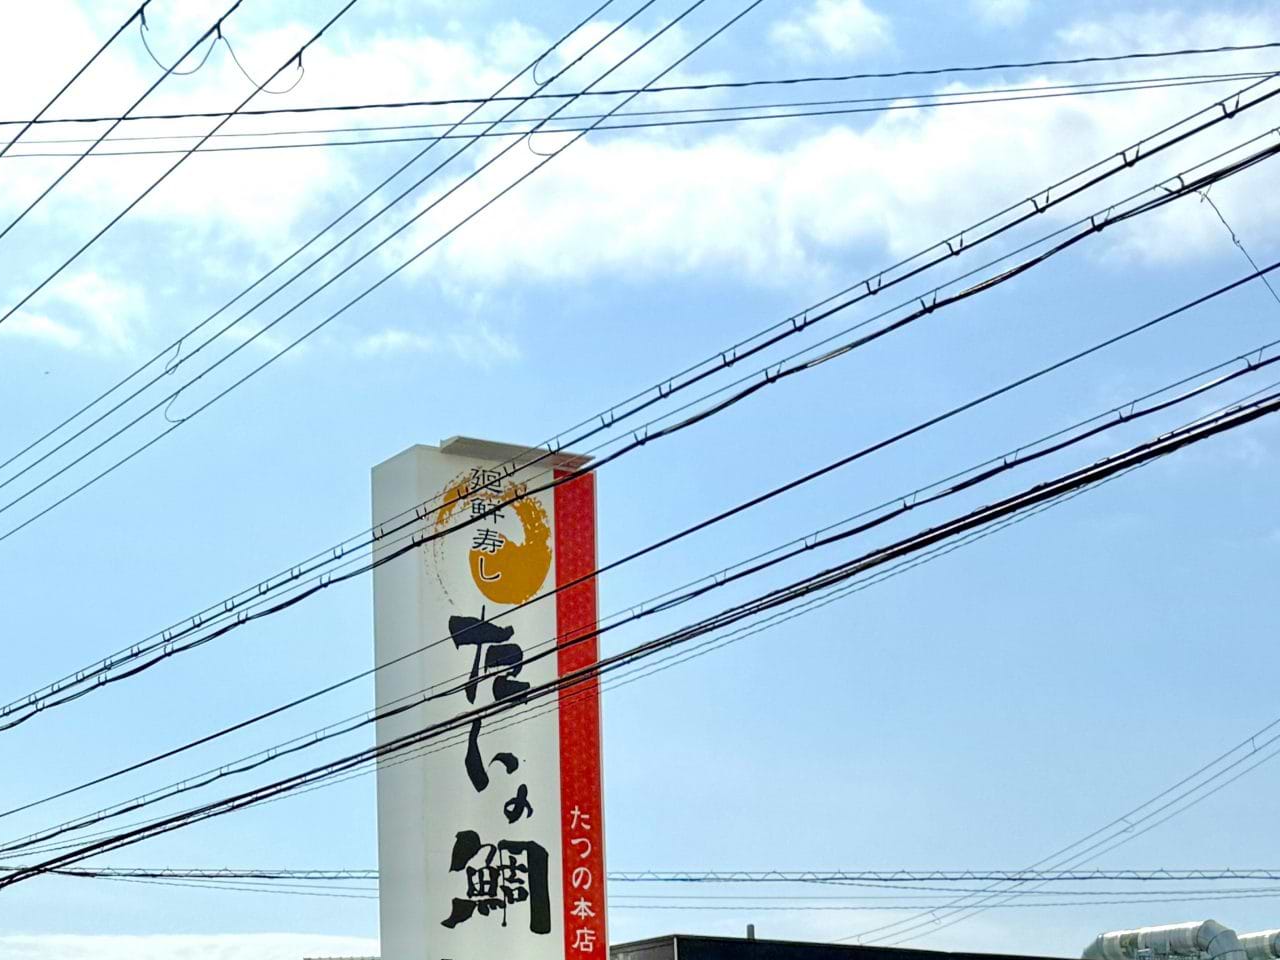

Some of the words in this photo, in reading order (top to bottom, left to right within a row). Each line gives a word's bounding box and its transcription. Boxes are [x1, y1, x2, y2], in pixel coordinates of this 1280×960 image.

[570, 805, 596, 953] たつの本店
